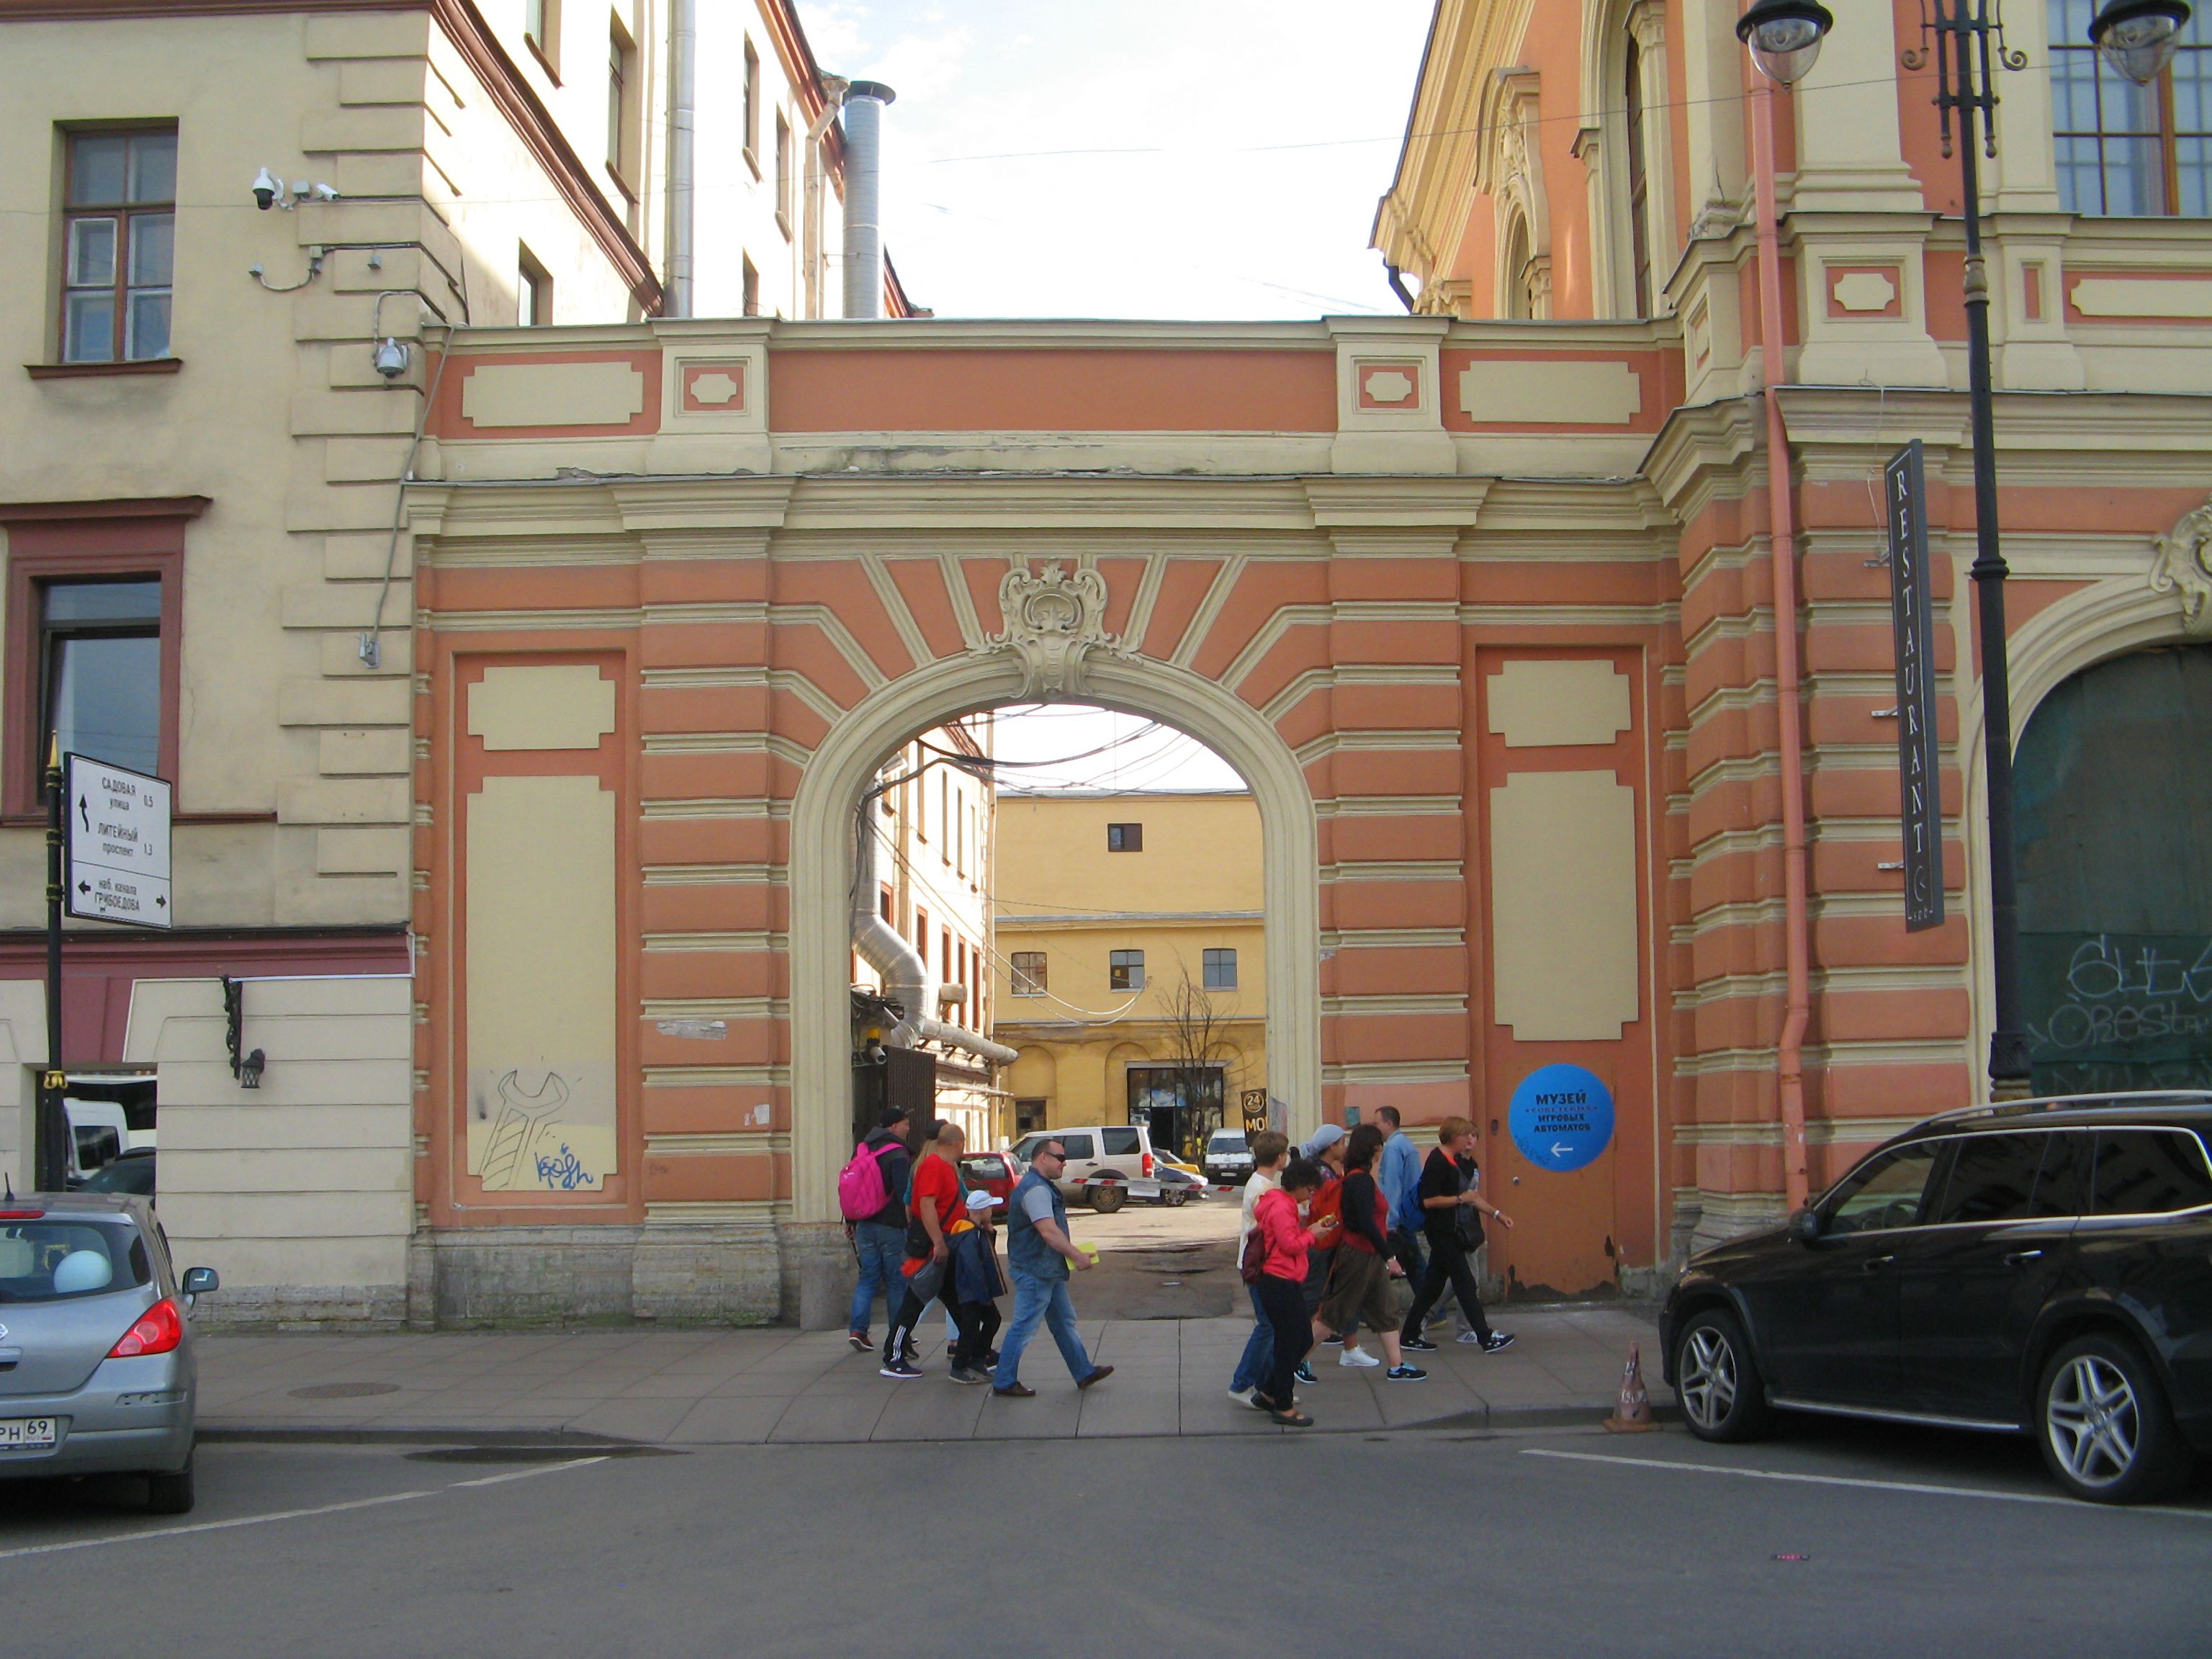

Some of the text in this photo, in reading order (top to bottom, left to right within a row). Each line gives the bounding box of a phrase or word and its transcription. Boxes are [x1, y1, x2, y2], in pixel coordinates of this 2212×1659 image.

[1896, 469, 1923, 853] RESTAURANT
[102, 776, 136, 796] САДОВАЯ
[94, 892, 140, 912] ГРИБОЕДОВА
[1246, 1095, 1260, 1107] 24
[1535, 1089, 1587, 1105] МУЗЕЙ
[1538, 1113, 1585, 1123] ИГРОВЫХ
[1534, 1123, 1591, 1133] АВТОМАТОВ
[27, 1420, 48, 1434] 69
